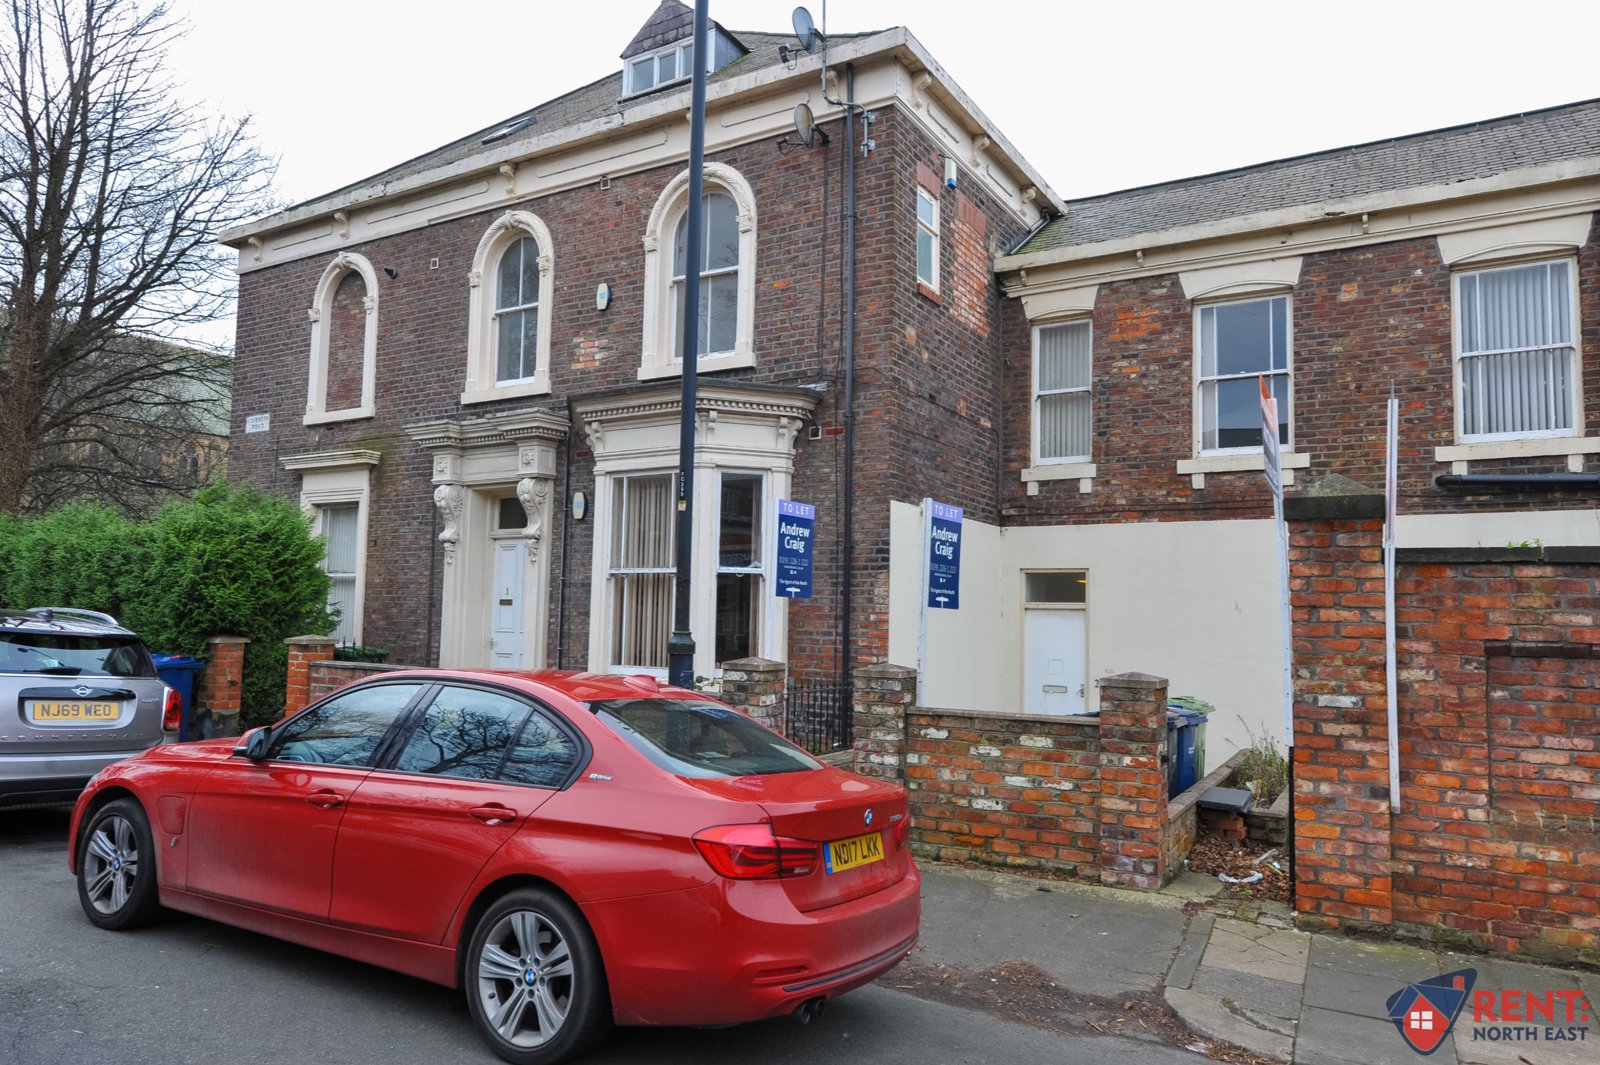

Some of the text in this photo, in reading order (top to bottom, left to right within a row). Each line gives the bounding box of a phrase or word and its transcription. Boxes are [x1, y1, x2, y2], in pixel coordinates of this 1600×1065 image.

[783, 502, 810, 515] TO LET
[934, 505, 958, 519] TO LET
[780, 521, 811, 538] Andrew
[931, 525, 959, 543] Andrew
[784, 536, 805, 554] Craig
[935, 541, 954, 560] Craig
[41, 703, 112, 717] NJ69 WEO
[834, 835, 880, 867] ND17 LKK
